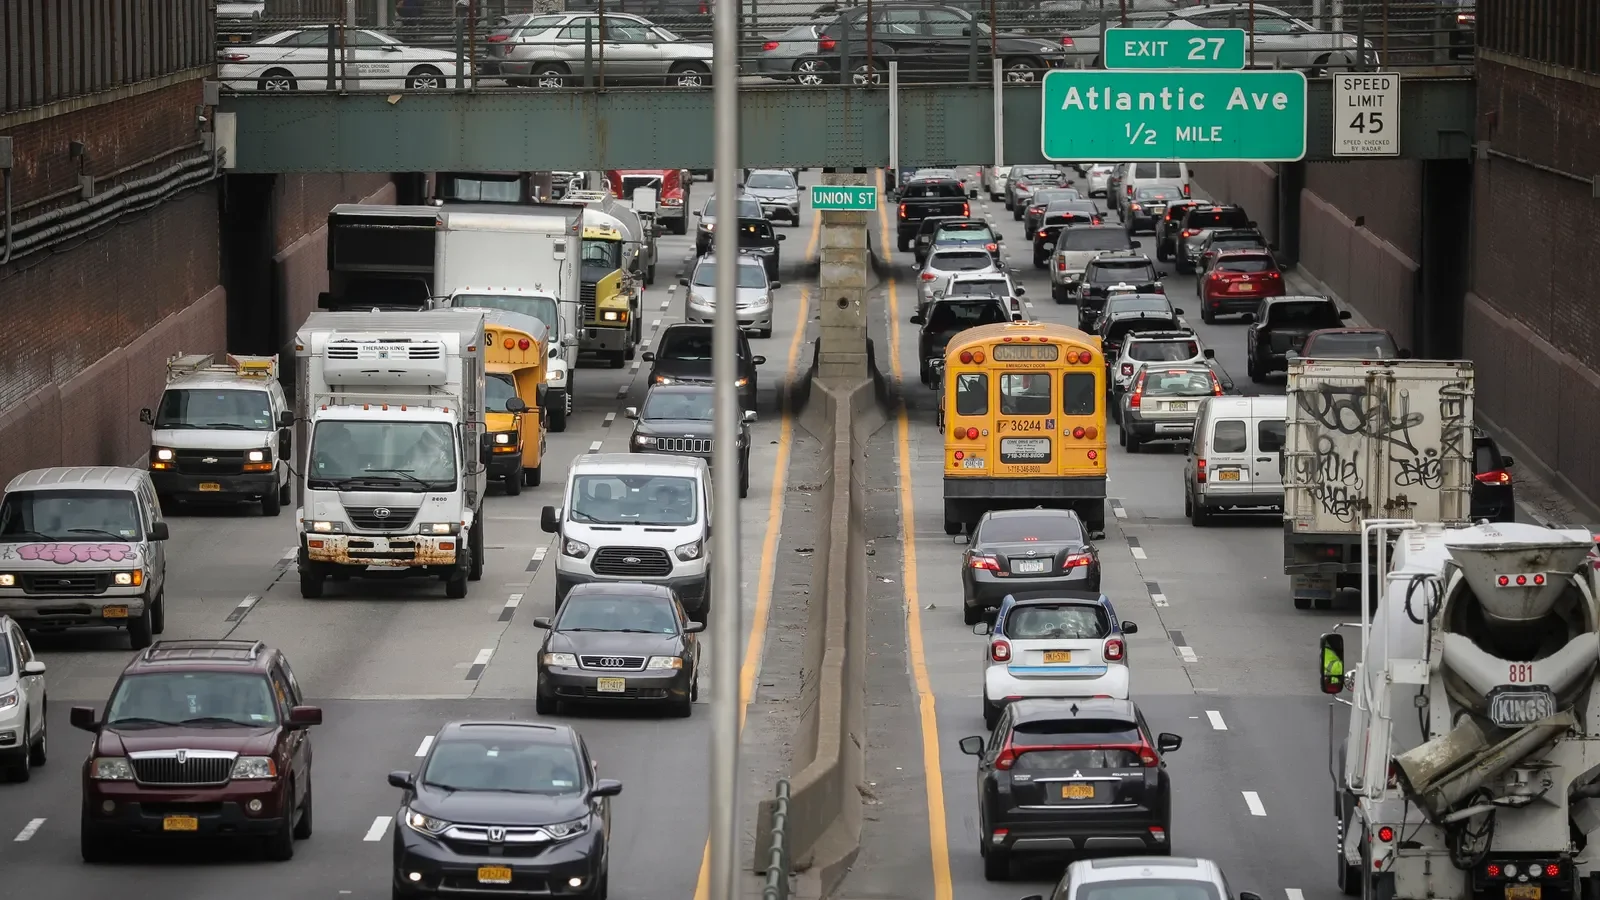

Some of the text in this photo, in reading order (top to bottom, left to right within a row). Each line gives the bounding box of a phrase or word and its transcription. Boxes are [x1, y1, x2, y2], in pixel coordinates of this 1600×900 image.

[1125, 37, 1225, 60] EXIT 27
[1344, 78, 1390, 90] SPEED
[1061, 86, 1288, 110] Atlantic Ave
[1348, 94, 1385, 107] LIMIT
[1349, 112, 1384, 134] 45
[1176, 126, 1222, 142] MILE
[813, 191, 874, 205] UNION ST
[995, 345, 1057, 360] SCHOOL BUS
[1011, 420, 1041, 431] 36244
[1509, 664, 1533, 683] 881
[1499, 698, 1547, 722] KINGS
